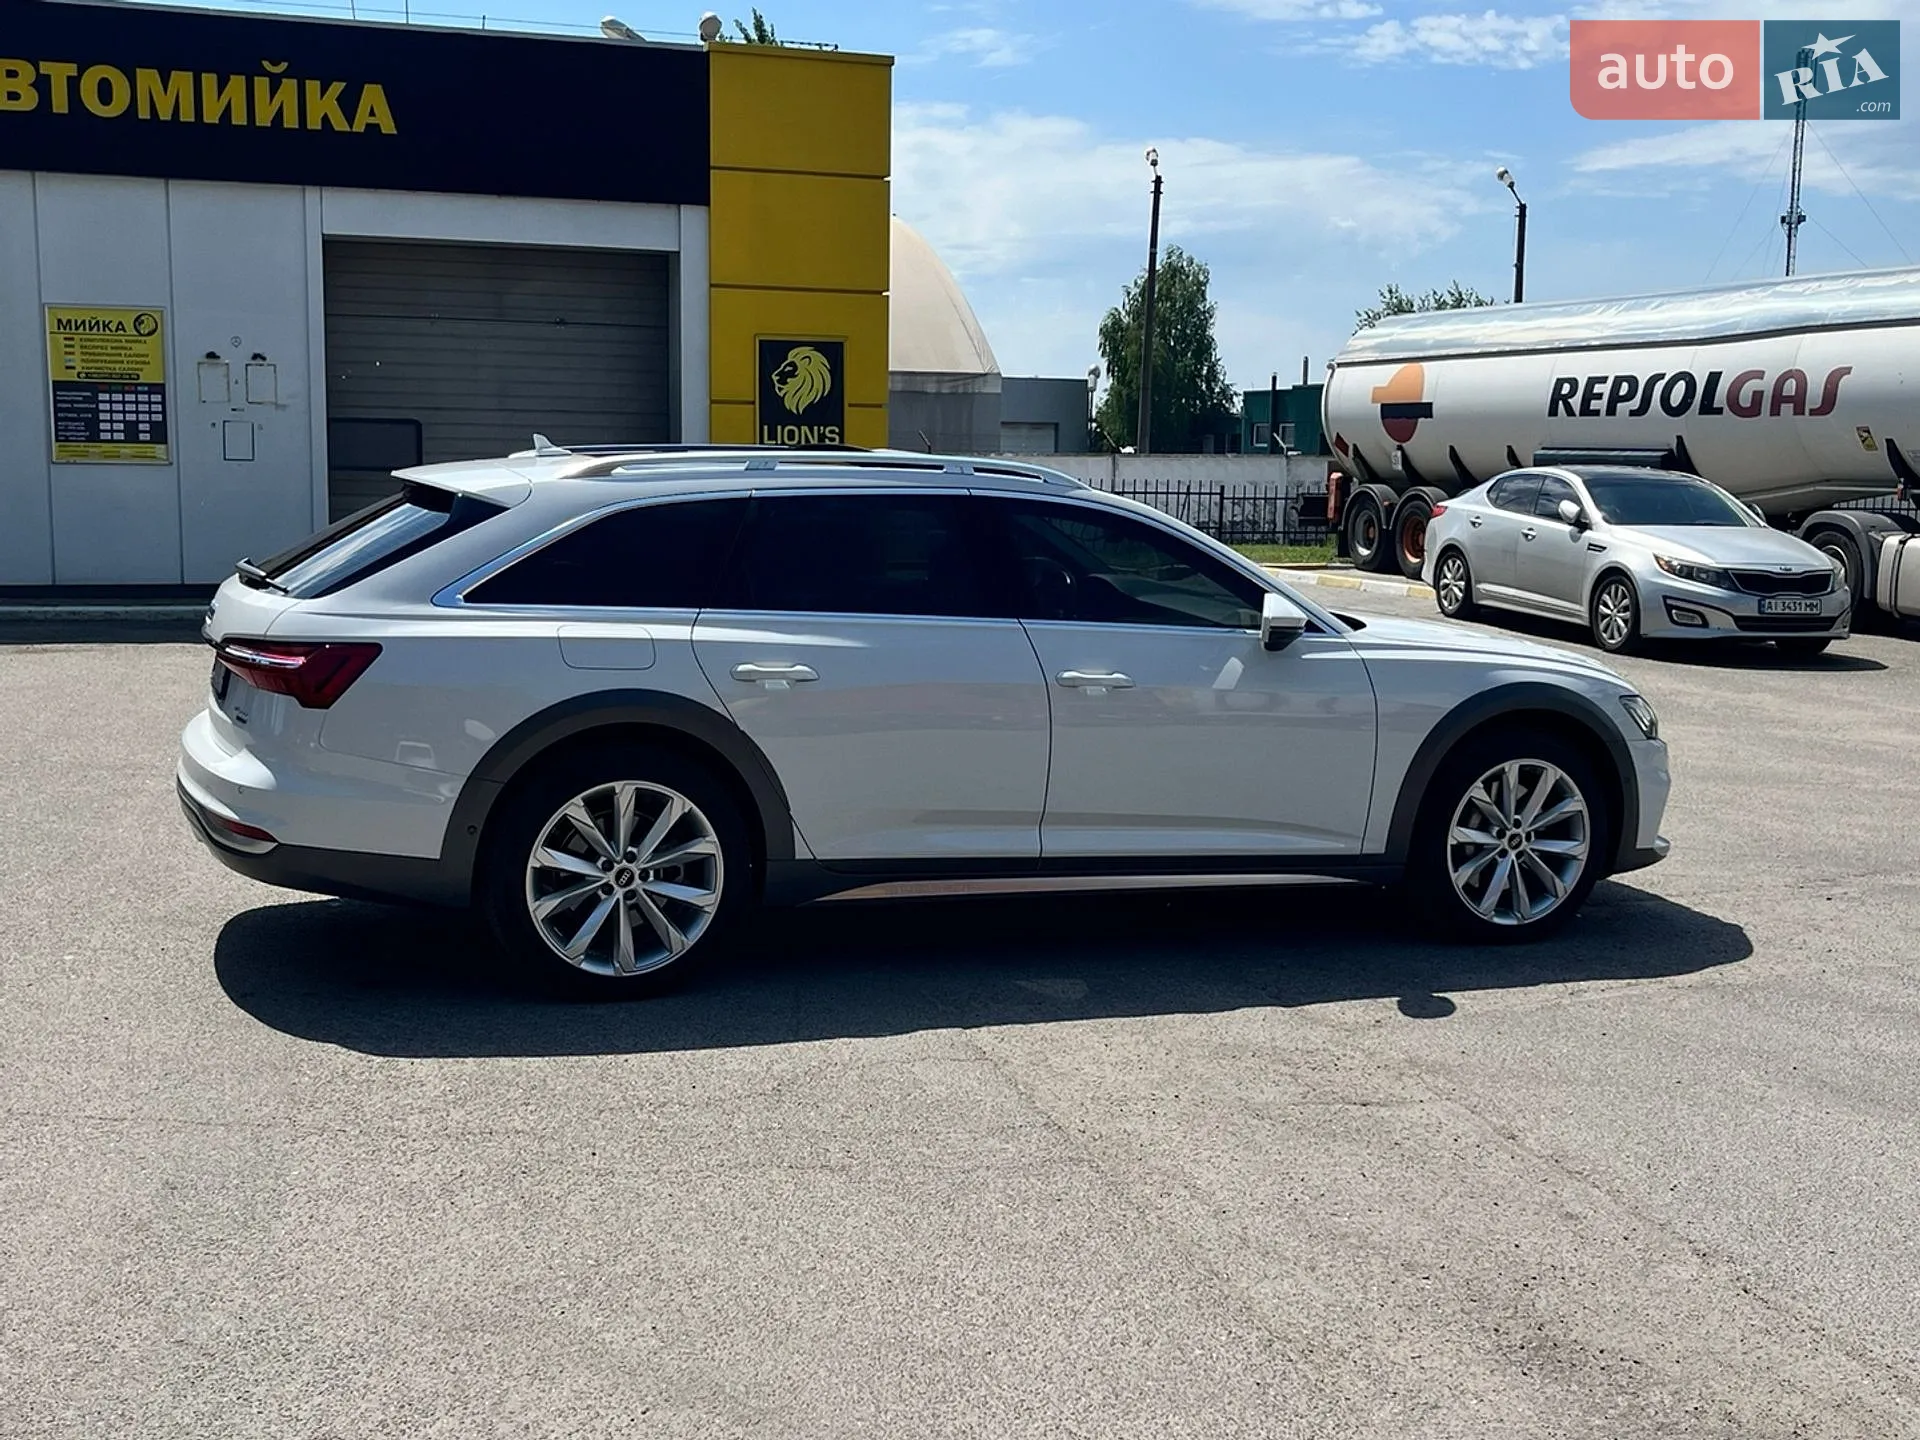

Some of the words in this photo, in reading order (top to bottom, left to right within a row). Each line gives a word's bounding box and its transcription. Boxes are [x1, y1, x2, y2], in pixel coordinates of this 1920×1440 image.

[0, 58, 398, 135] ВТОМИЙКА
[56, 316, 127, 333] МИЙКА
[763, 425, 840, 445] LION'S
